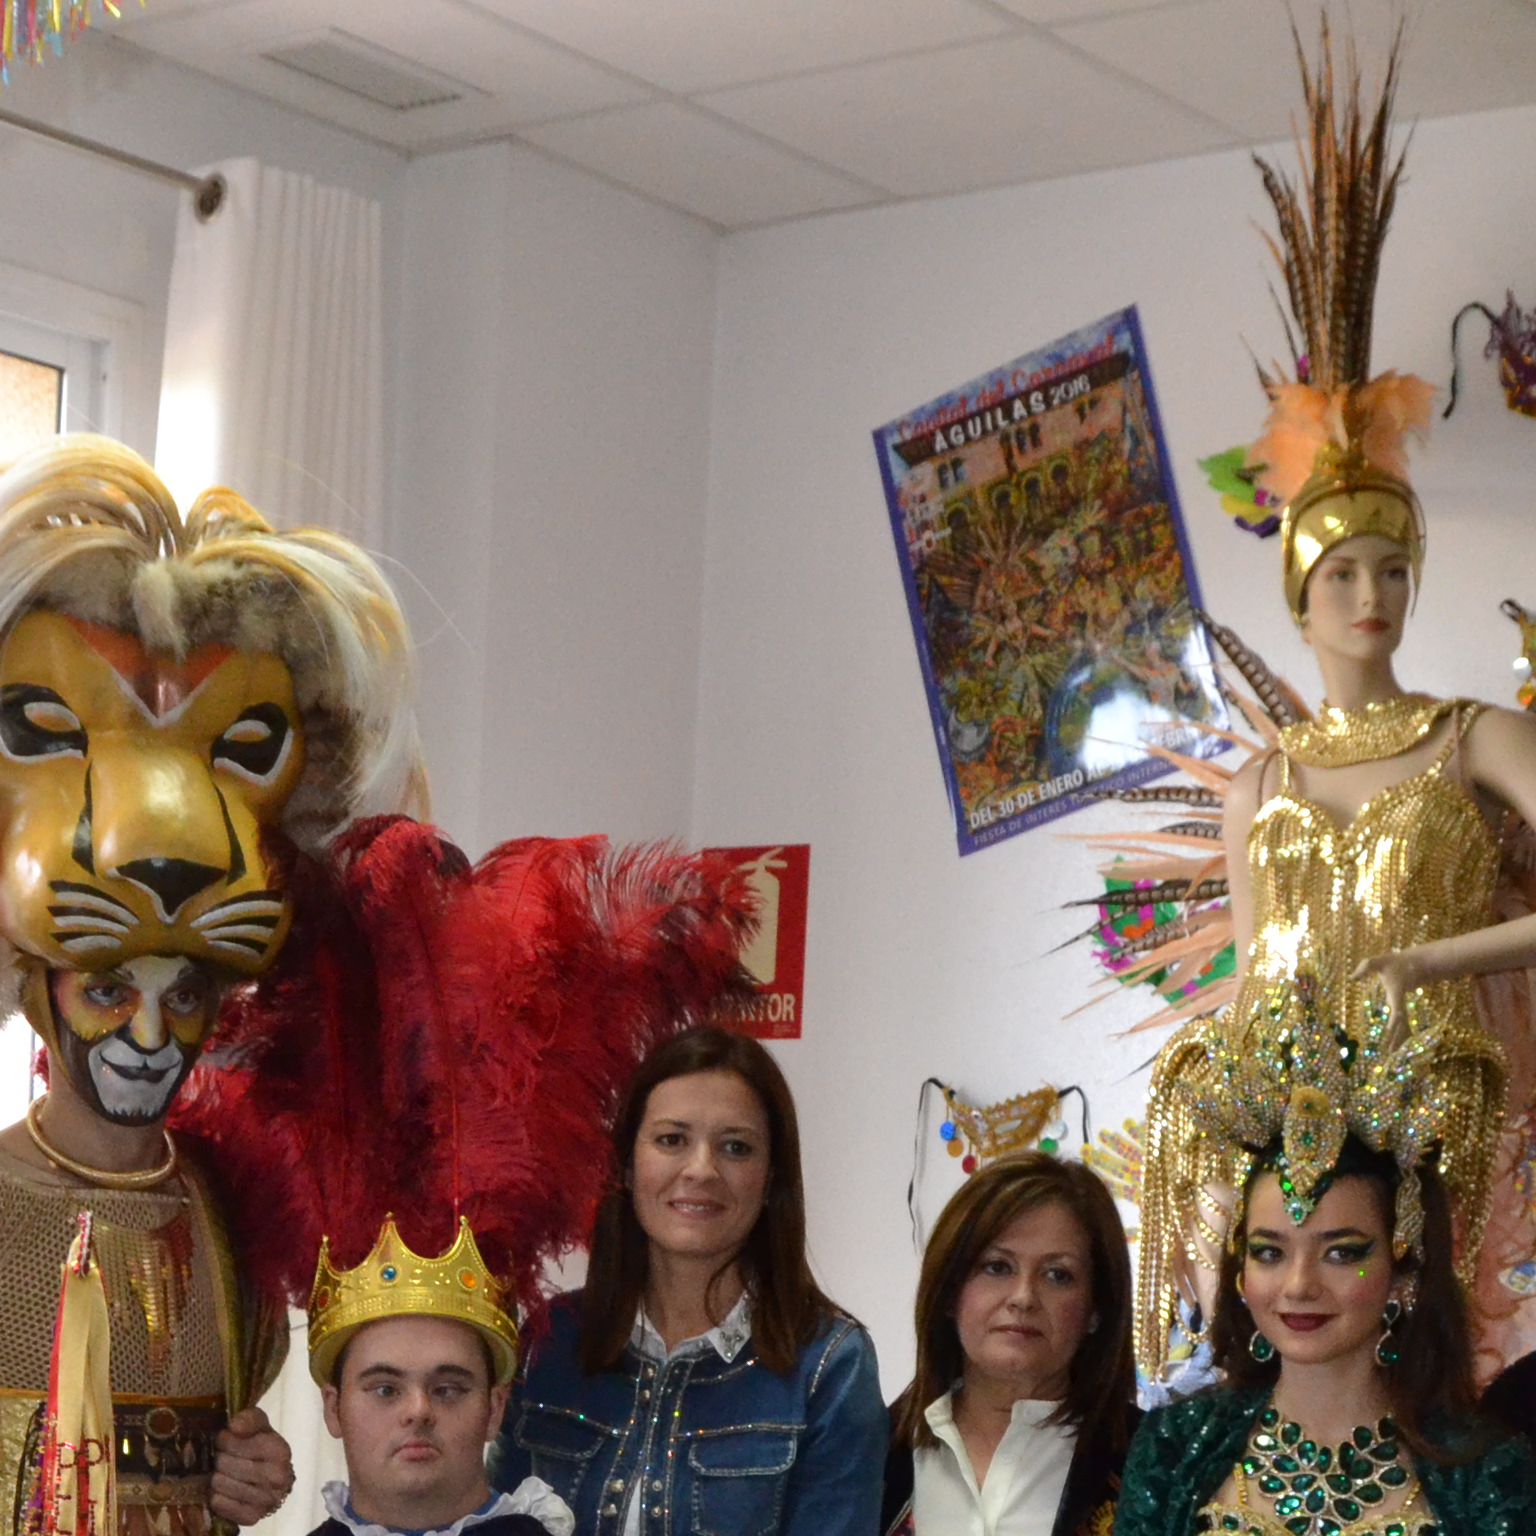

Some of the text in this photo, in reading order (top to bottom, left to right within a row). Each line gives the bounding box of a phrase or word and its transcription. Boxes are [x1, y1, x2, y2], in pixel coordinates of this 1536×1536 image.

[1050, 374, 1091, 406] 2016
[970, 805, 997, 830] DEL
[999, 798, 1015, 818] 30
[1017, 788, 1037, 811] DE
[1039, 768, 1084, 801] ENERO
[974, 828, 1006, 847] FIESTA
[1008, 820, 1023, 833] DE
